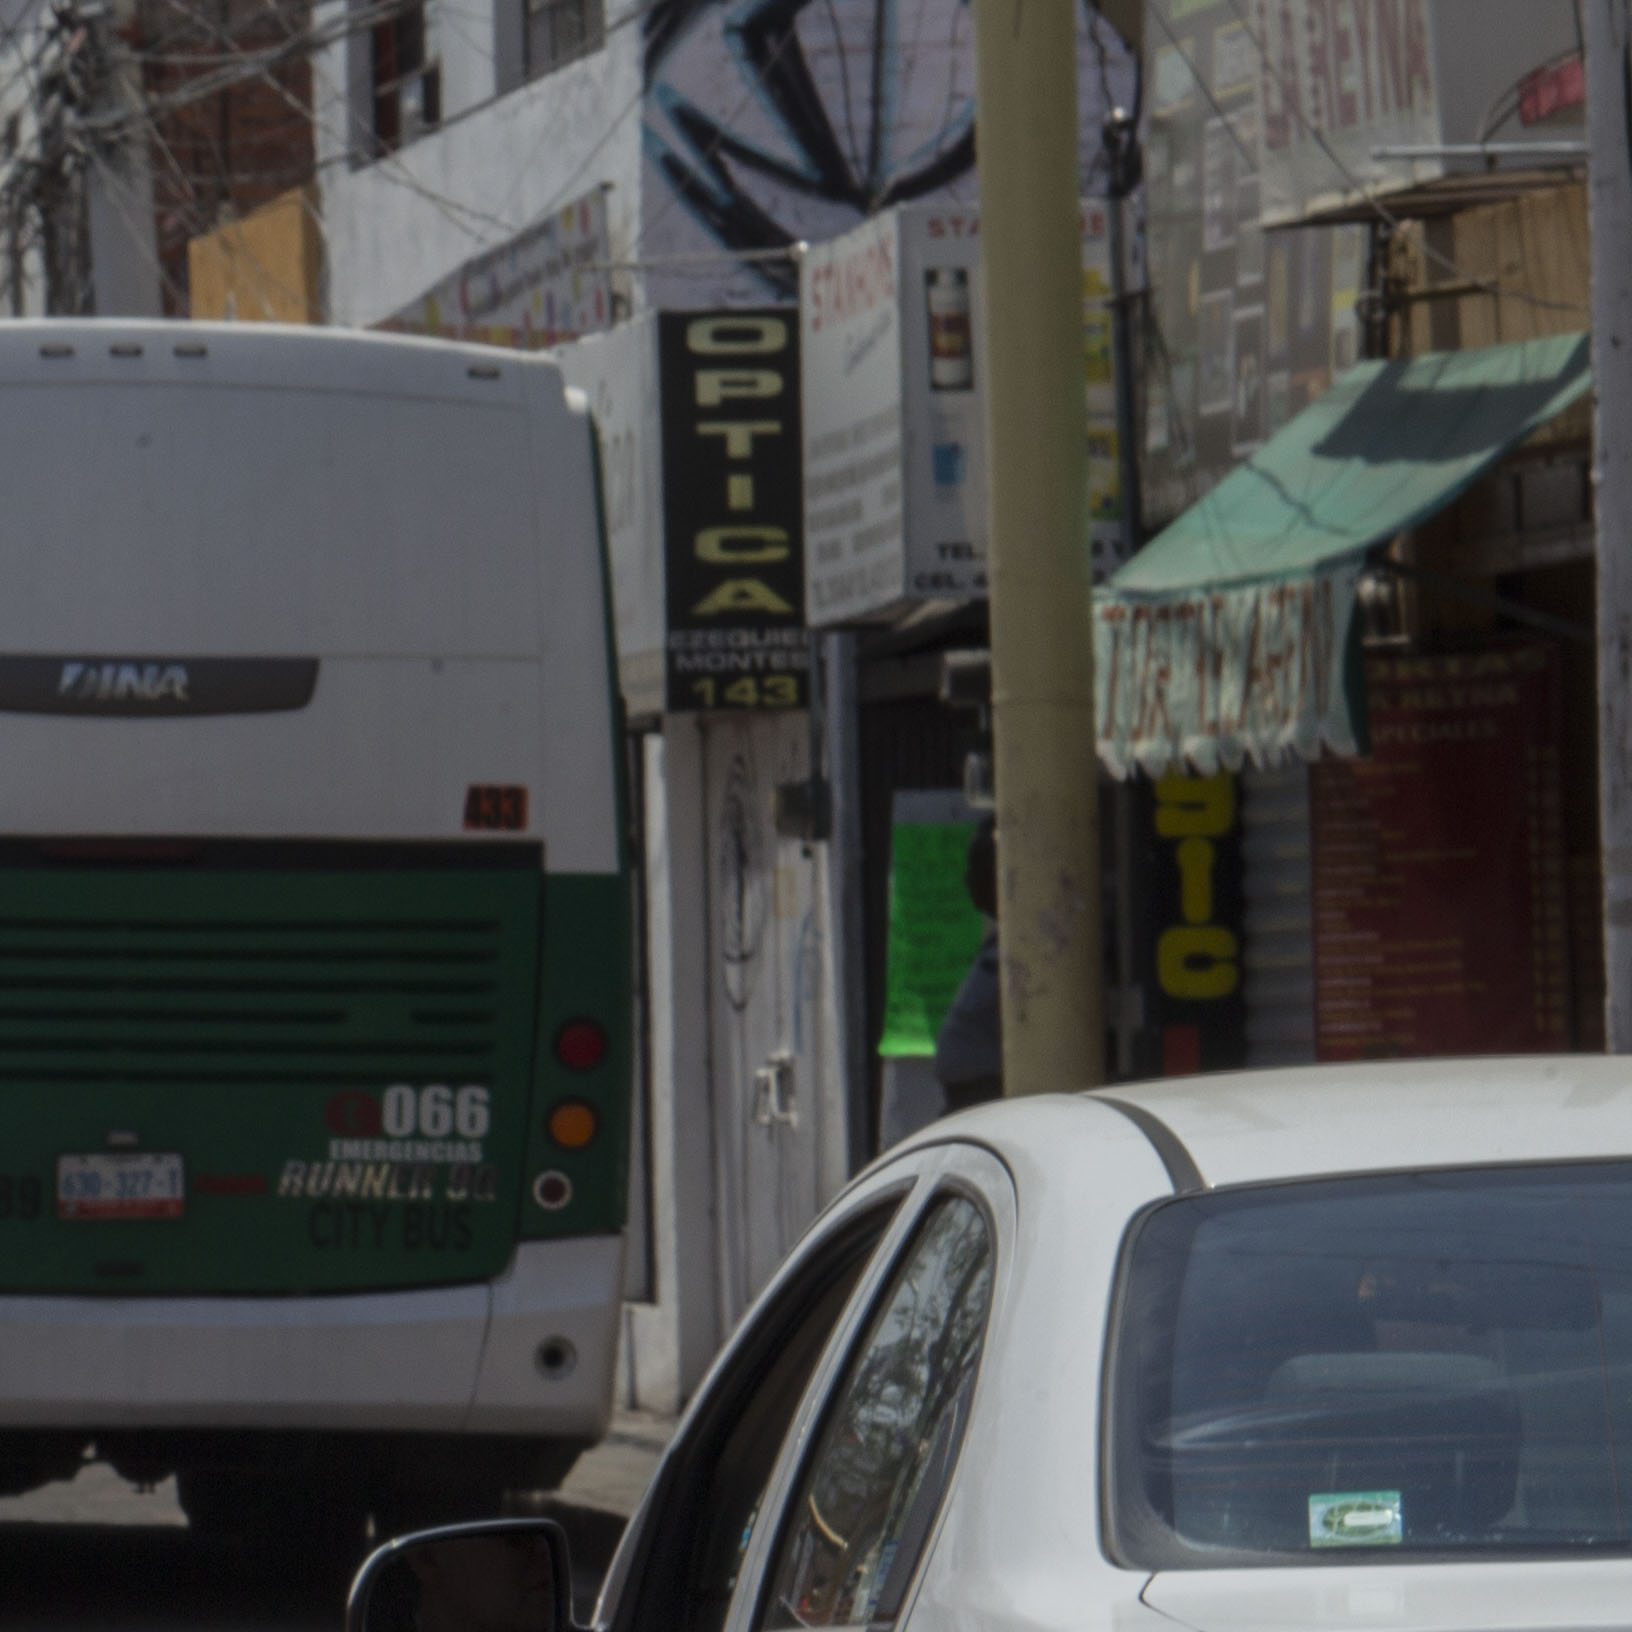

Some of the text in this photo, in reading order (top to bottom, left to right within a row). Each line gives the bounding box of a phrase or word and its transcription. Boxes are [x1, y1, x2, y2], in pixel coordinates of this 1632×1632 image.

[685, 315, 795, 616] OPTICA
[675, 652, 809, 672] MONTES
[692, 674, 799, 707] 143
[382, 1083, 490, 1138] 066
[309, 1203, 474, 1251] CITY BUS
